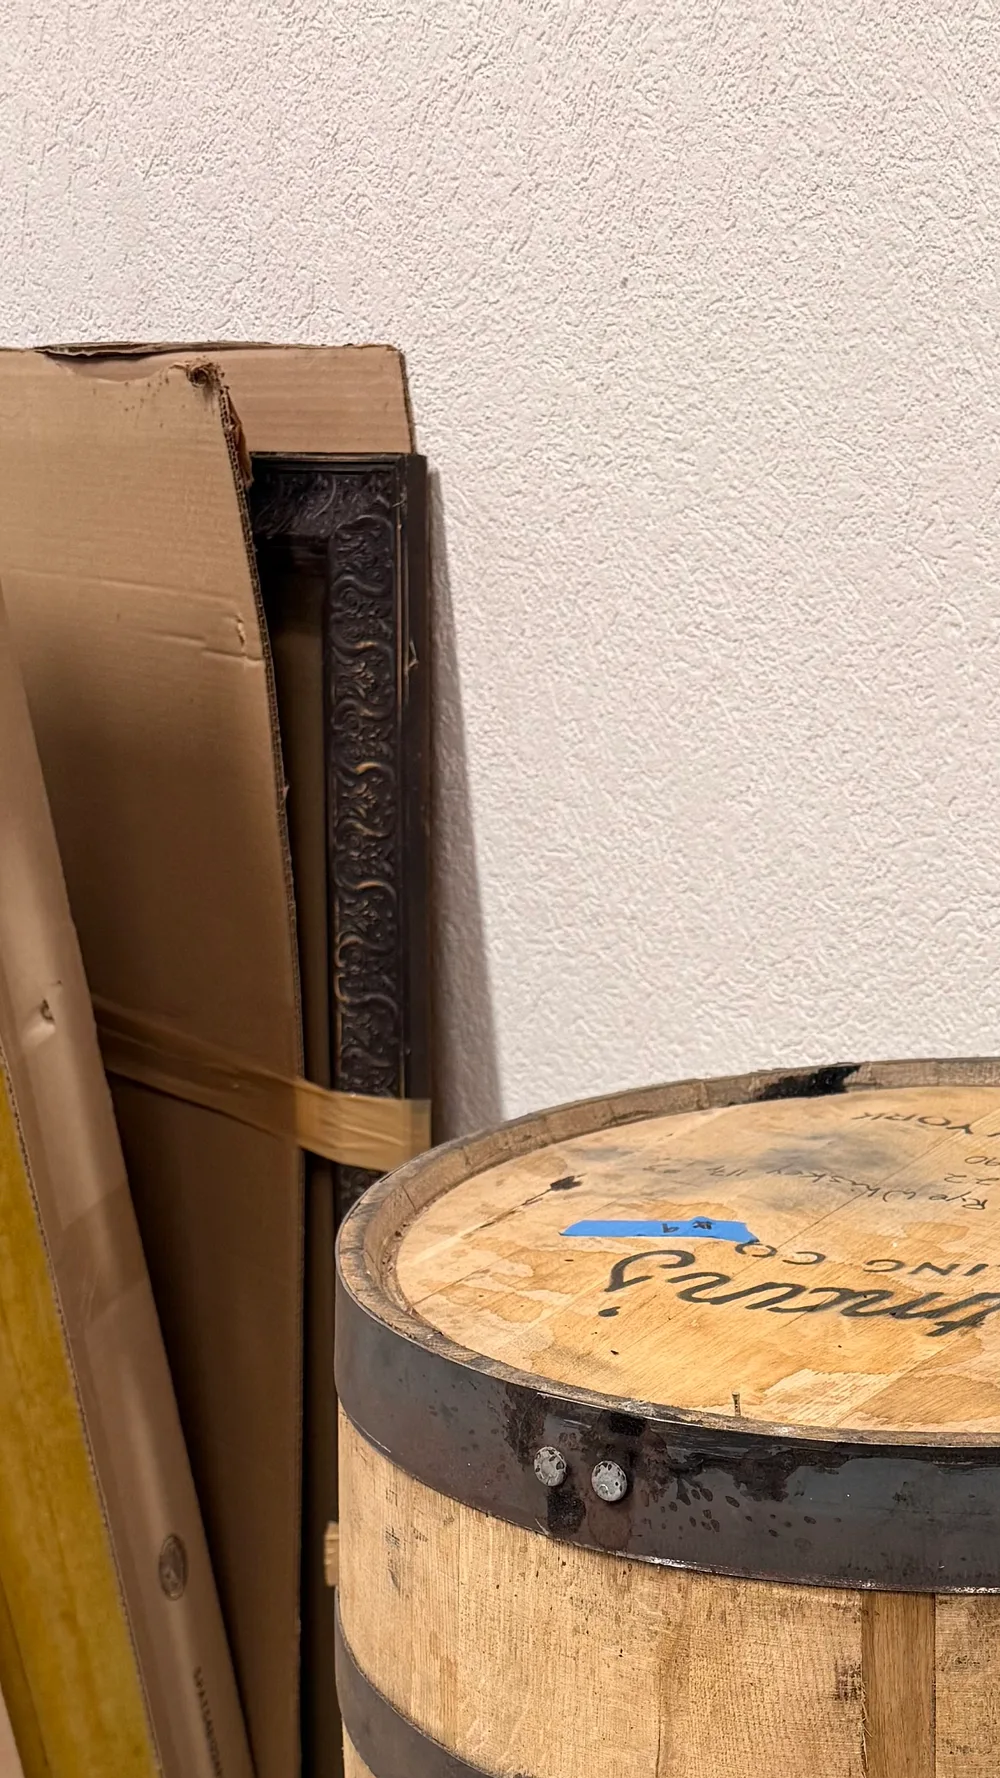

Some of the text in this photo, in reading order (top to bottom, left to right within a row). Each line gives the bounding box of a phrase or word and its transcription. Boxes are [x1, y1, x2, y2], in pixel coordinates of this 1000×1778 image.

[852, 1112, 974, 1135] YORK
[766, 1163, 917, 1202] Whiskey
[928, 1190, 988, 1211] Rye
